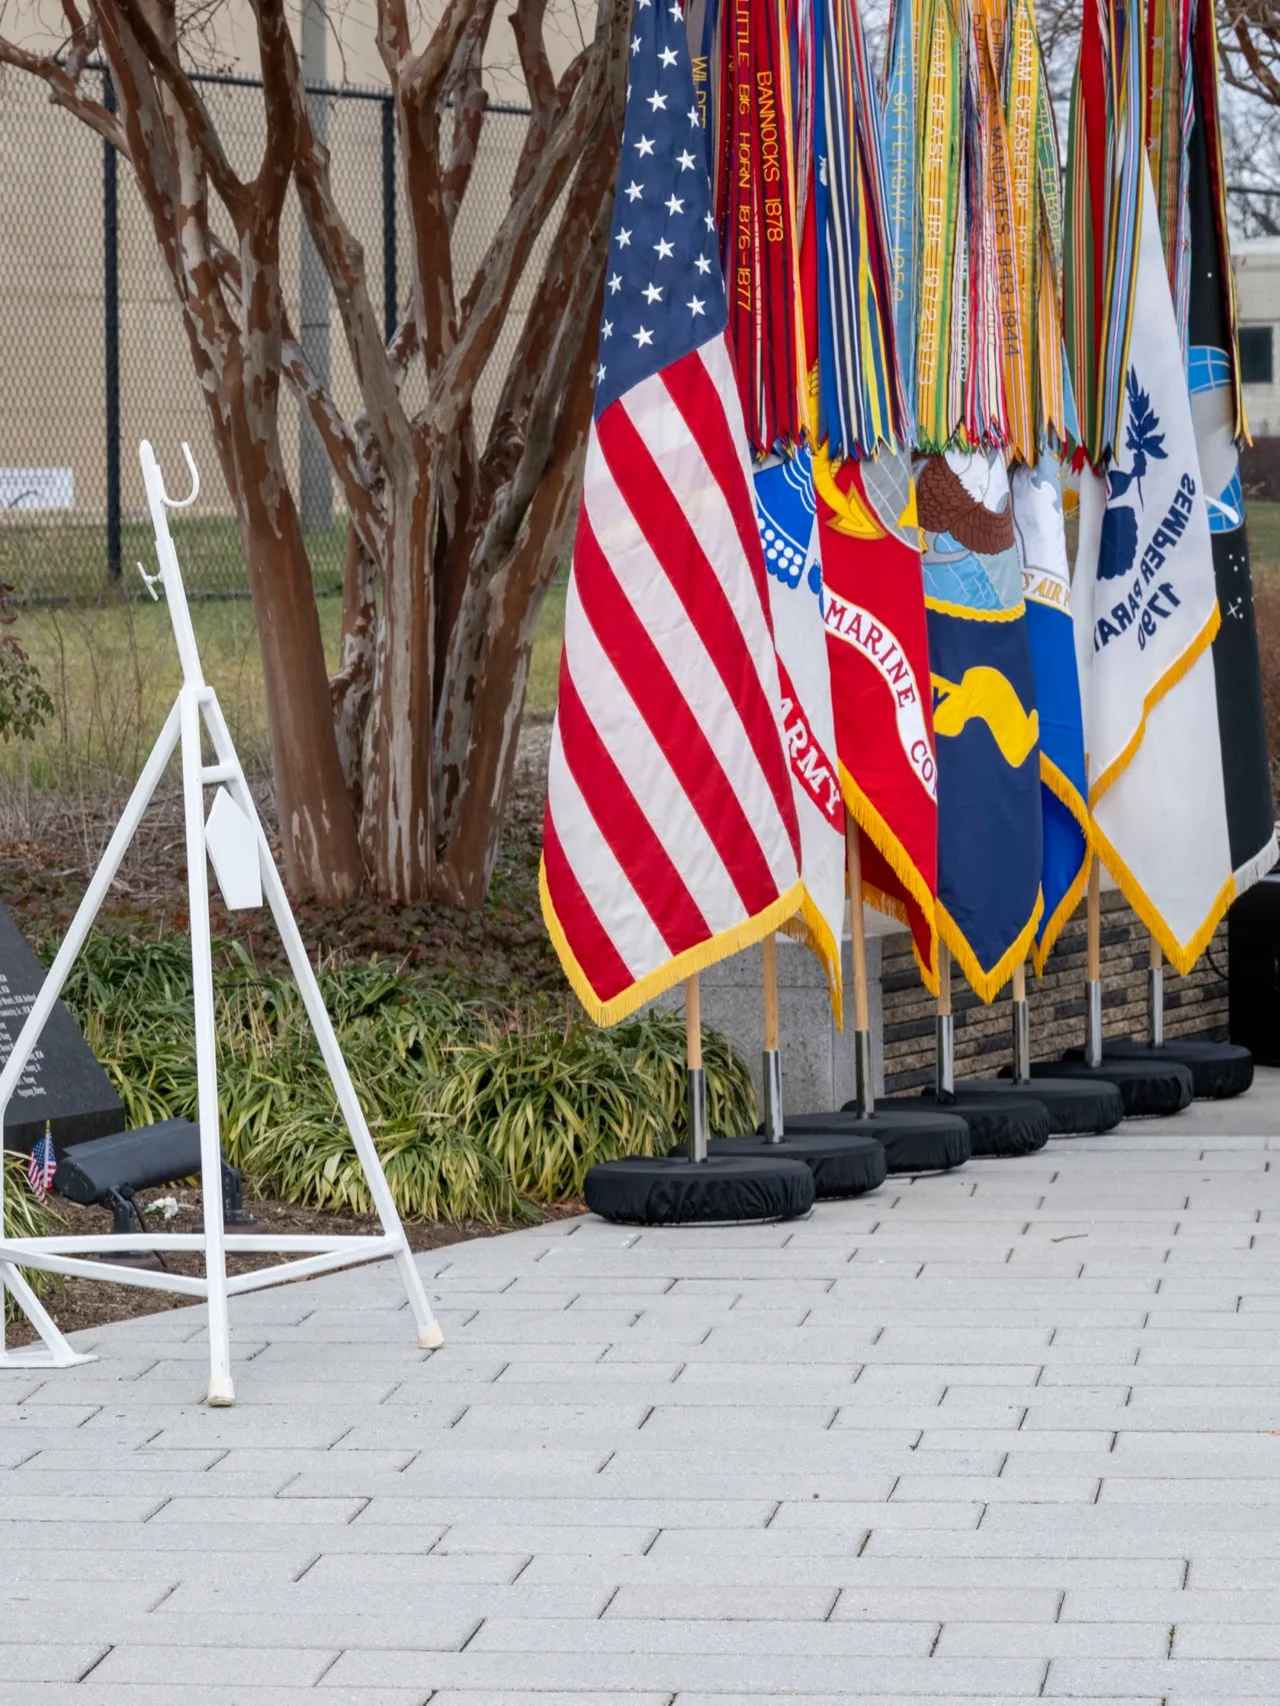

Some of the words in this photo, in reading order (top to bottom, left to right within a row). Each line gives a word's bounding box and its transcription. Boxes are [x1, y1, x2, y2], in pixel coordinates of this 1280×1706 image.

[738, 84, 751, 115] BIG
[756, 71, 780, 182] BANNOCKS
[928, 93, 945, 170] CEASE
[1014, 95, 1033, 208] CEASEFIRE
[738, 132, 752, 188] HORN
[891, 93, 908, 230] OFFENSIVE
[991, 126, 1009, 236] MANDATES
[737, 205, 752, 312] 1876-1877
[764, 199, 784, 242] 1878
[999, 248, 1020, 356] 1943-1944
[1033, 577, 1063, 604] AIR
[824, 598, 916, 708] MARINE
[780, 697, 841, 815] ARMY
